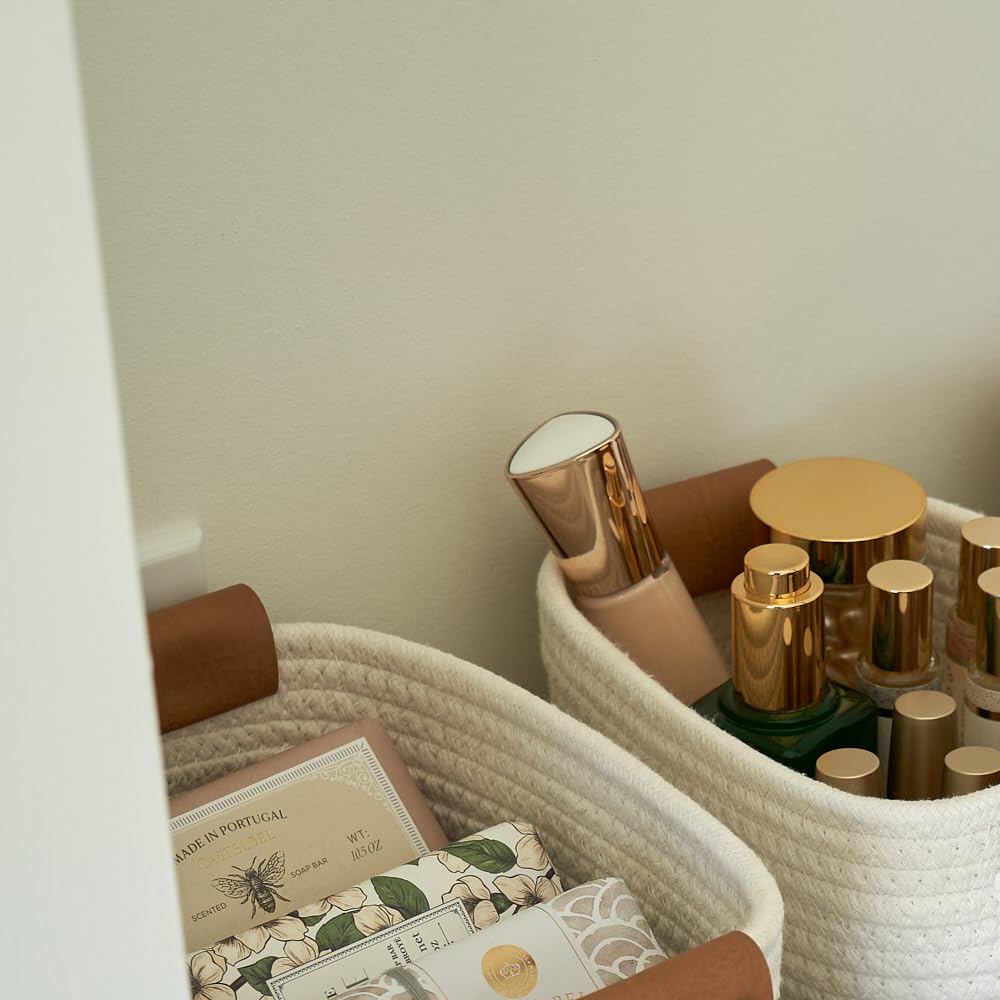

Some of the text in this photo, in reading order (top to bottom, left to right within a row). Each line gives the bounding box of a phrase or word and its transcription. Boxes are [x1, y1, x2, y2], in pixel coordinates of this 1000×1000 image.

[173, 810, 288, 866] MADE IN PORTUGAL
[368, 839, 383, 855] OZ
[191, 857, 329, 922] SCENTED SOAP BAR
[386, 943, 400, 962] BAR
[412, 932, 428, 953] net
